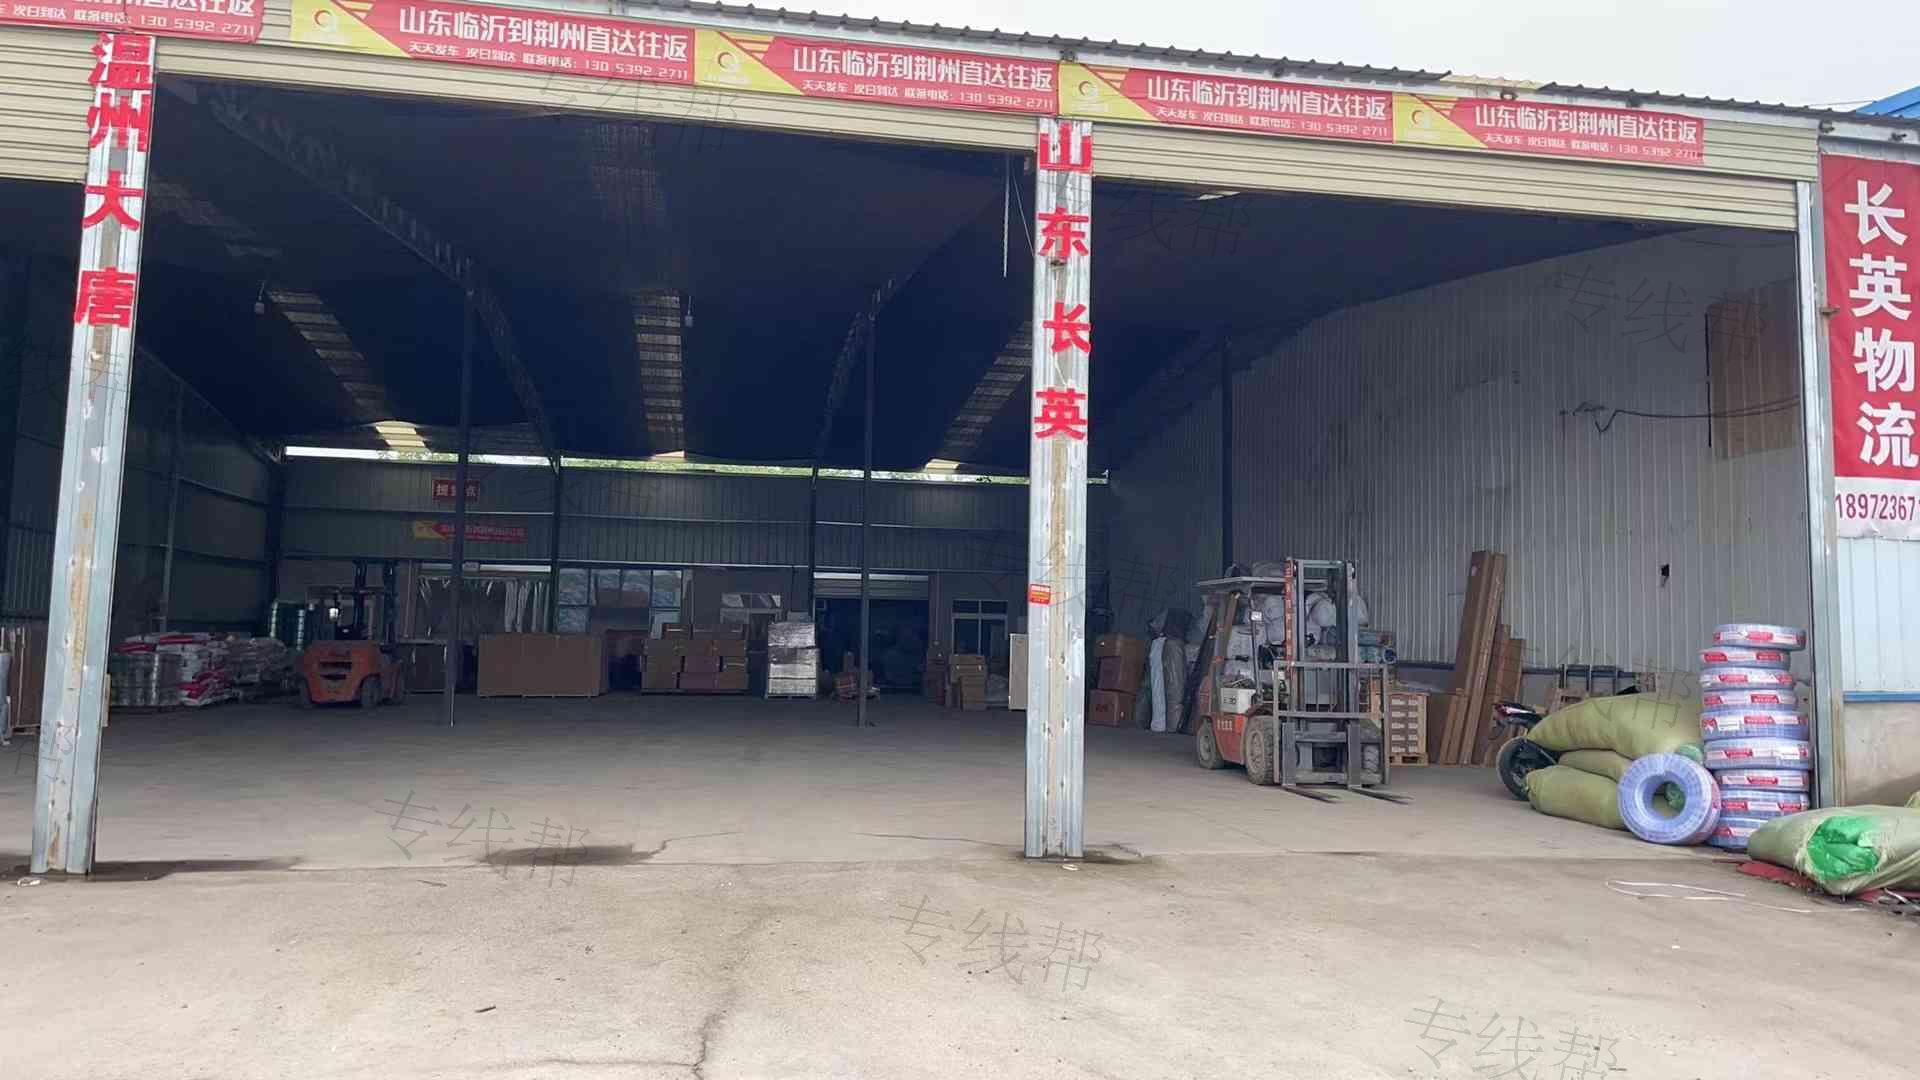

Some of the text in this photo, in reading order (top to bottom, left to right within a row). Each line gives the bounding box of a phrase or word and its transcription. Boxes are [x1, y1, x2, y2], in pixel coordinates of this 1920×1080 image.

[141, 15, 167, 27] 130
[174, 18, 216, 32] 5392
[221, 22, 254, 36] 2711
[399, 6, 689, 63] 山东临沂到荆州直达往返
[585, 59, 609, 71] 130
[616, 63, 652, 76] 5392
[658, 67, 688, 80] 2711
[793, 46, 1052, 92] 山东临沂到荆州直达往返
[960, 91, 982, 103] 130
[1026, 97, 1053, 110] 2711
[1147, 75, 1386, 120] 山东临沂到荆州直达往返
[1301, 120, 1320, 131] 130
[1362, 126, 1387, 136] 2711
[1475, 103, 1697, 144] 山东临沂到荆州直达往返
[73, 32, 152, 328] 温州大唐
[1034, 122, 1092, 440] 山东长英
[1844, 180, 1919, 468] 长英物流
[1835, 493, 1920, 520] 18972367
